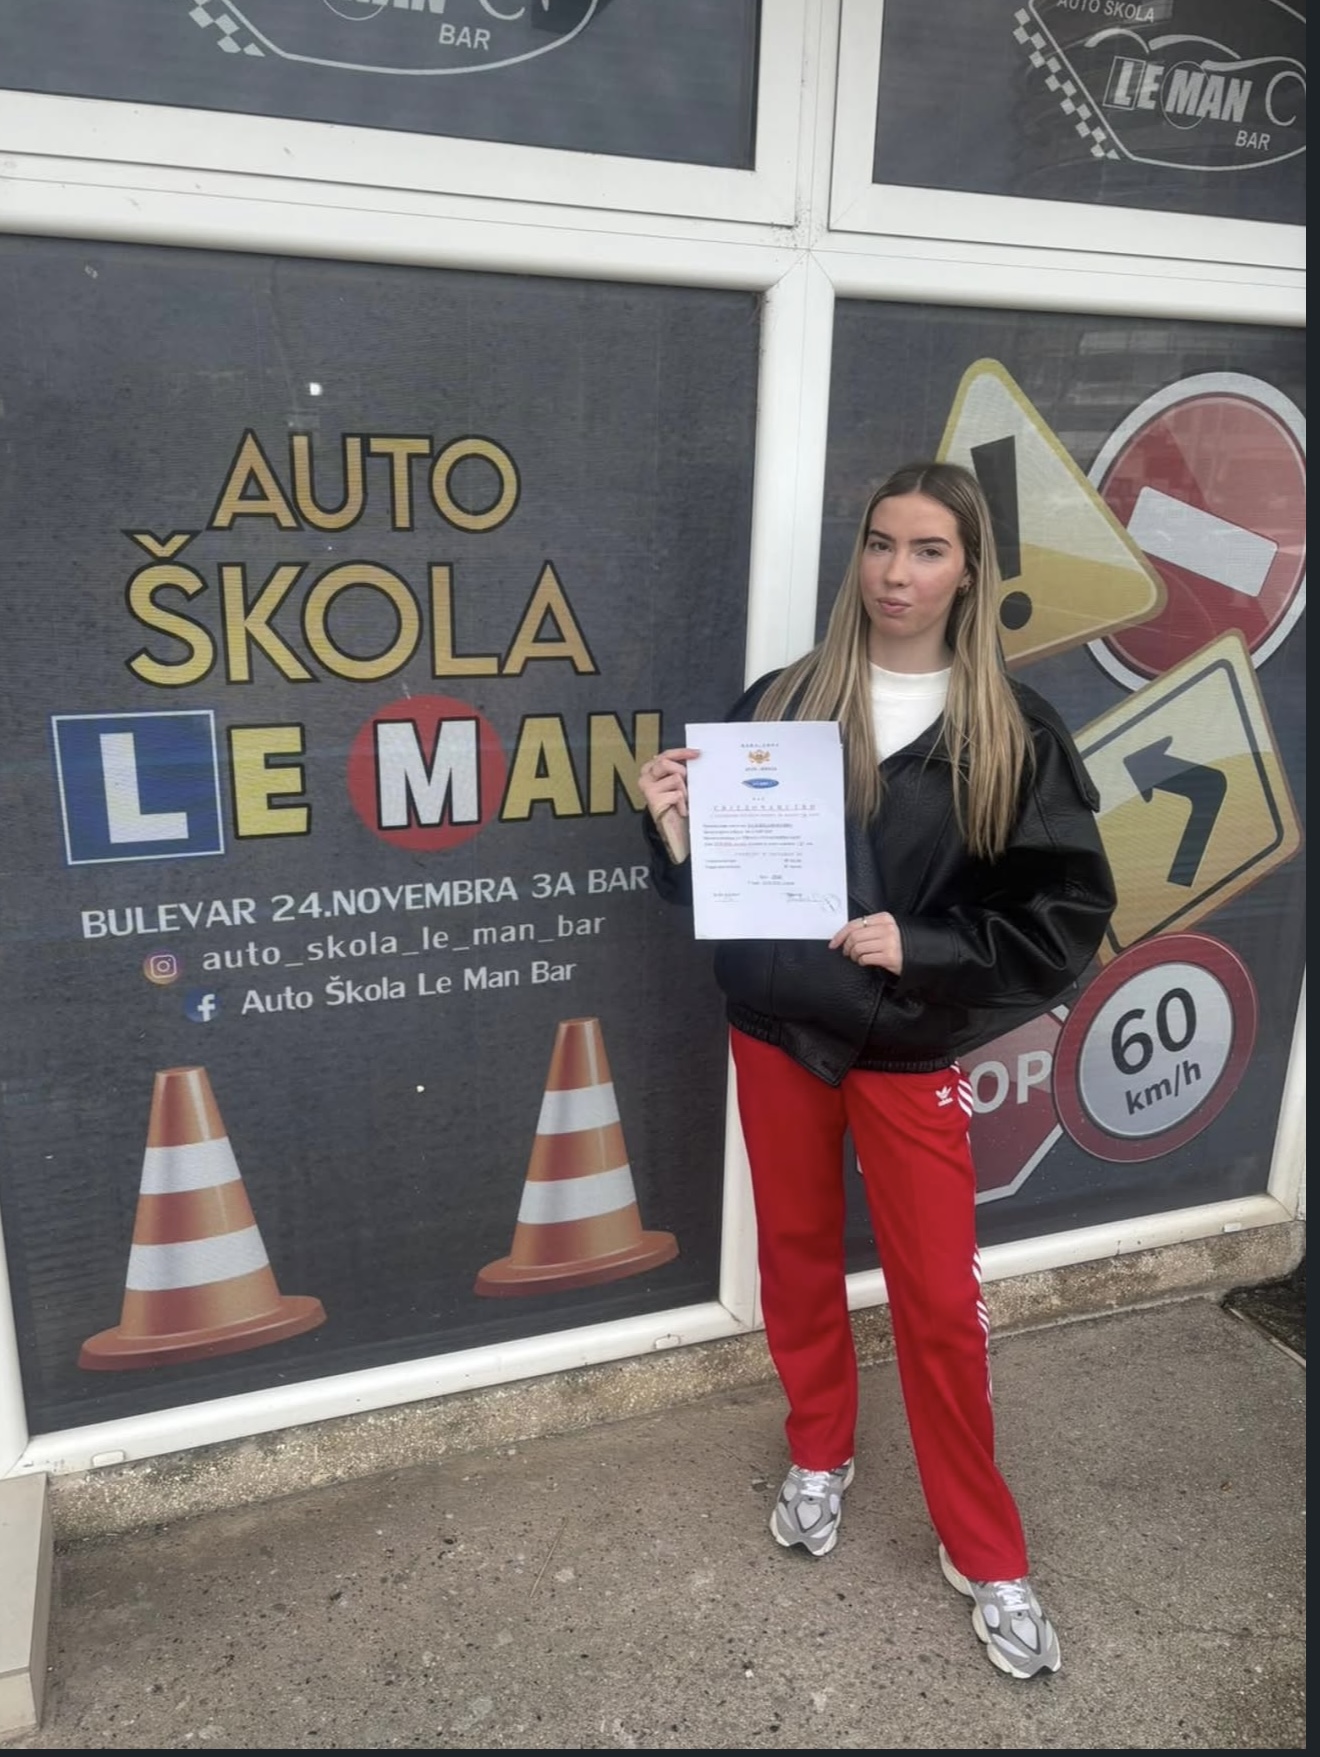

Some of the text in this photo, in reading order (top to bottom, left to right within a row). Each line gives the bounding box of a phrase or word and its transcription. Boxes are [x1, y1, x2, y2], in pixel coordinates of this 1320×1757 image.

[438, 23, 491, 50] BAR
[1165, 69, 1253, 123] MAN
[1234, 130, 1271, 150] BAR
[205, 428, 521, 533] AUTO
[120, 529, 600, 689] ŠKOLA
[373, 709, 664, 831] MAN
[81, 865, 650, 939] BULEVAR 24.NOVEMBRA 3A BAR
[202, 914, 606, 971] auto_skola_le_man_bar
[241, 986, 313, 1016] Auto
[325, 975, 405, 1006] Škola
[418, 972, 452, 996] Le
[464, 966, 519, 991] Man
[531, 960, 577, 984] Bar
[1110, 987, 1196, 1075] 60
[972, 1049, 1053, 1115] OP
[1125, 1059, 1202, 1116] km/h
